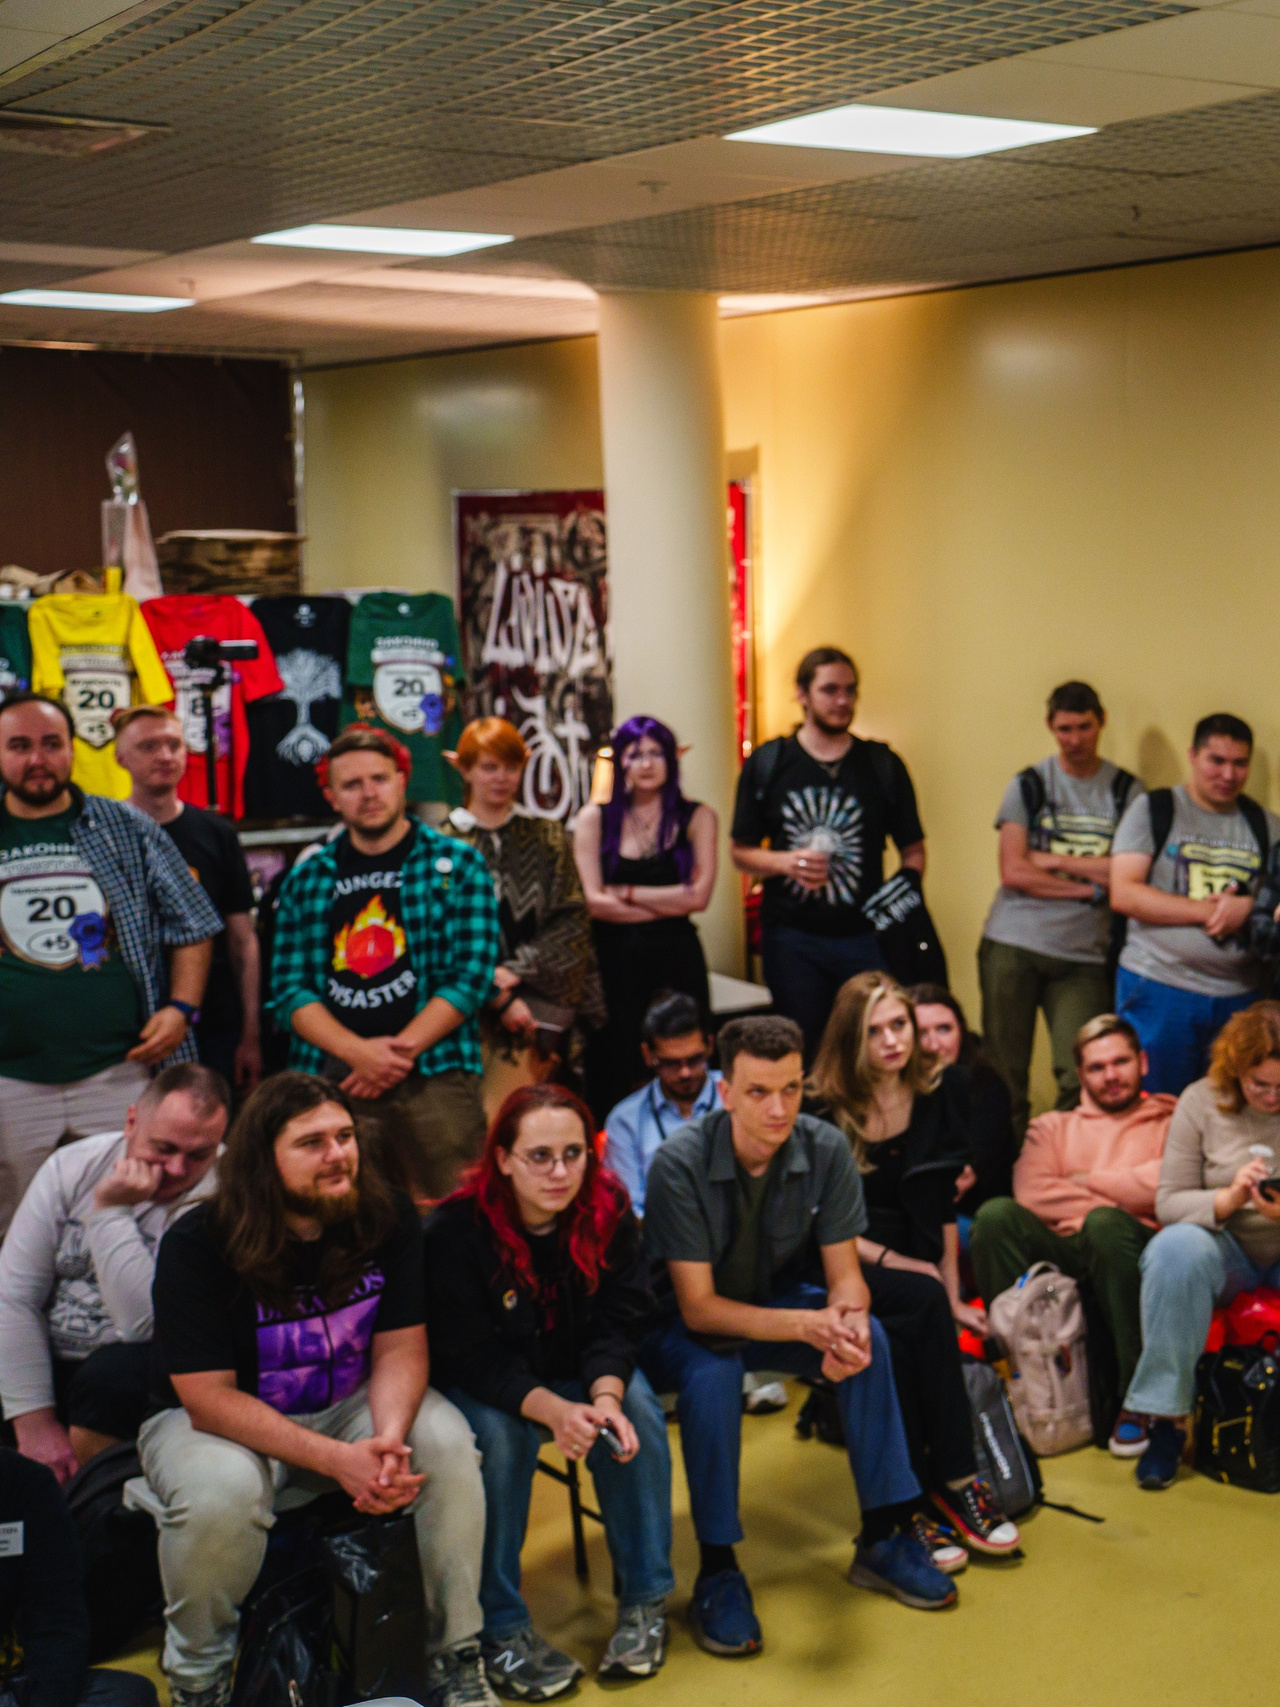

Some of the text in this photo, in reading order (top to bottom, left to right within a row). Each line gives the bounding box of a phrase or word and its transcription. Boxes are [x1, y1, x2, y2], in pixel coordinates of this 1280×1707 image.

[394, 677, 425, 697] 20
[78, 689, 115, 709] 20
[0, 842, 80, 861] ЗАКОНН
[332, 870, 403, 900] UNGE
[27, 895, 76, 923] 20
[493, 1650, 526, 1674] N
